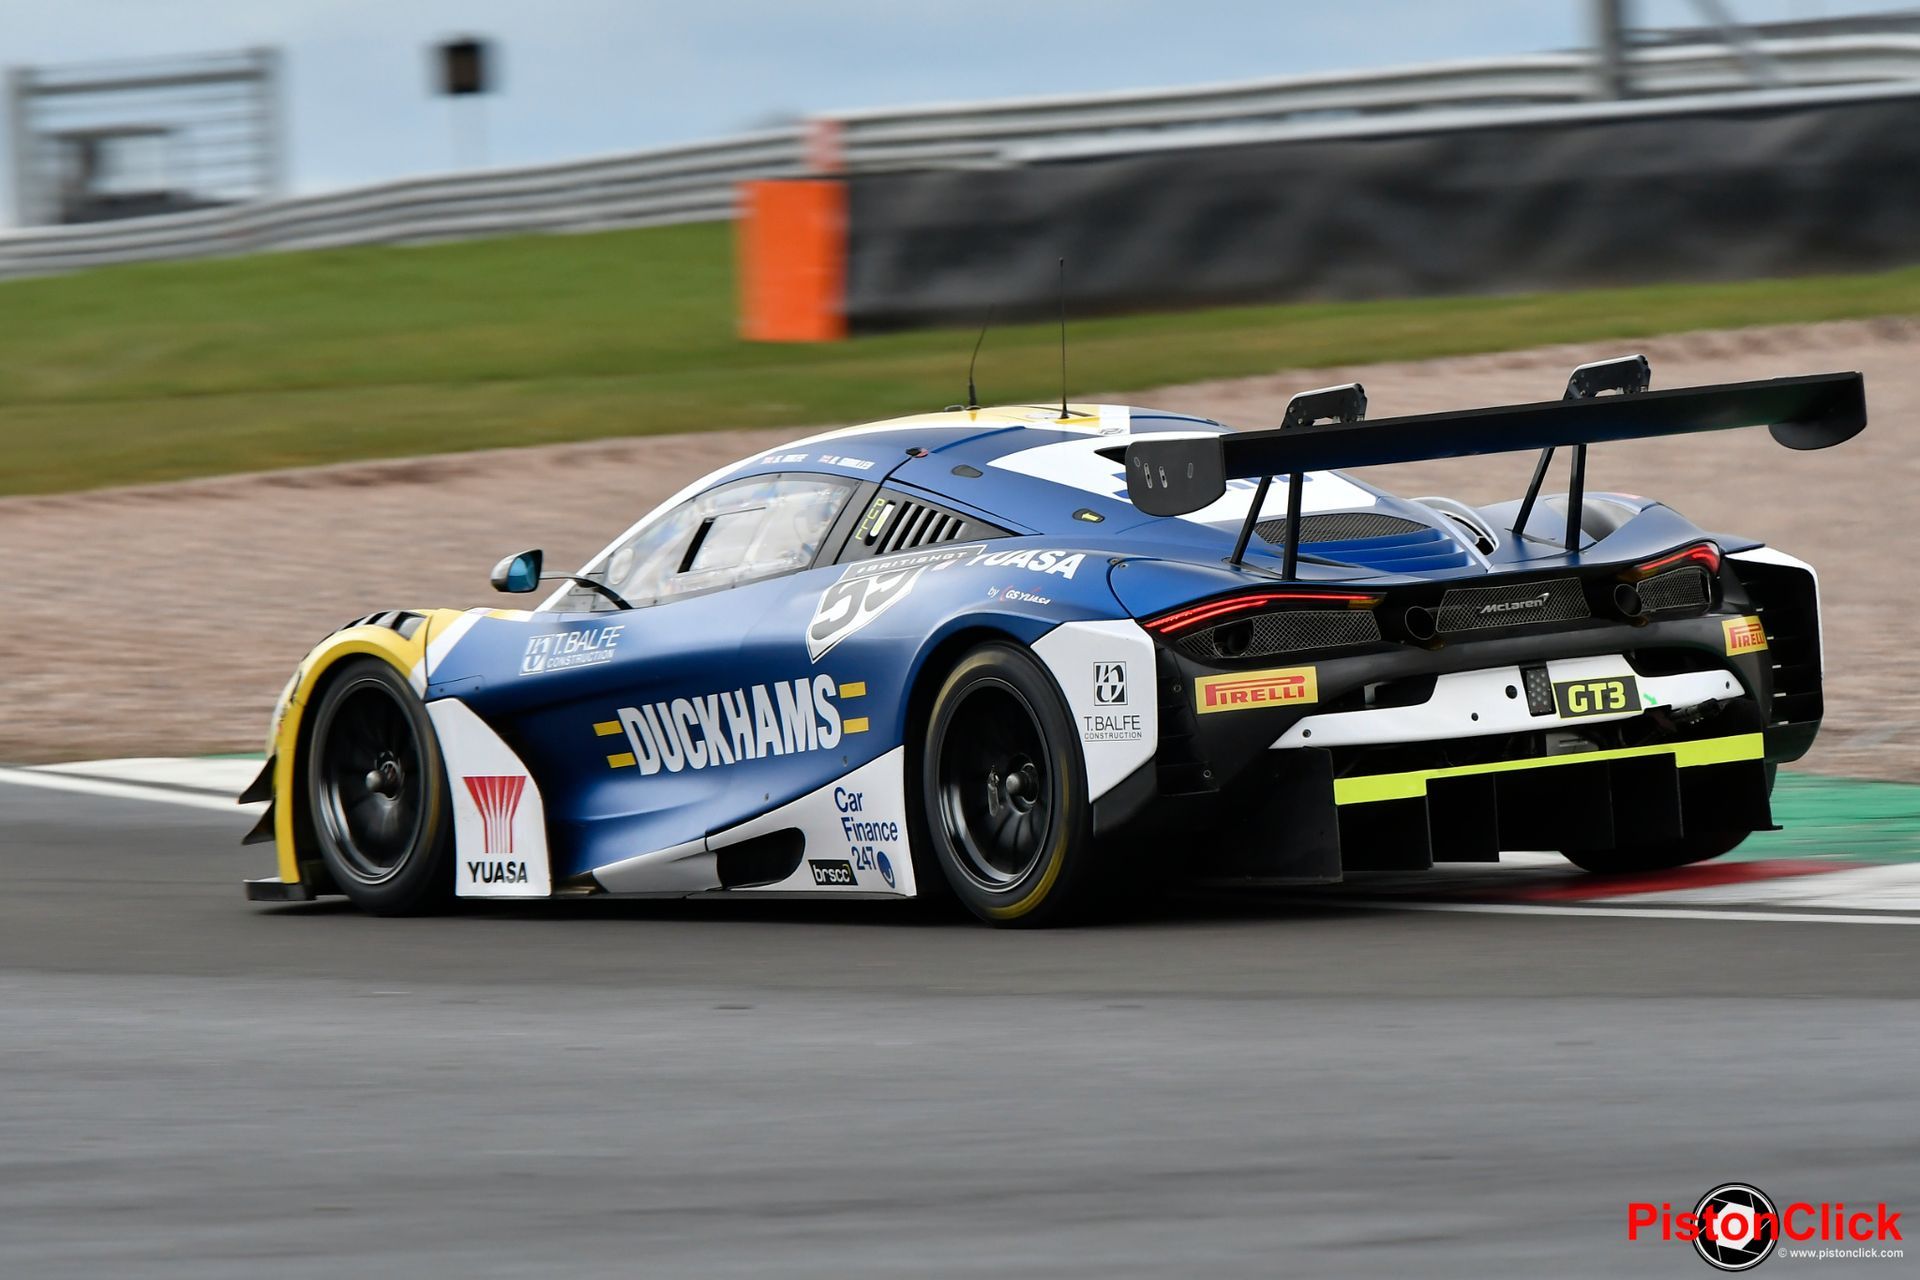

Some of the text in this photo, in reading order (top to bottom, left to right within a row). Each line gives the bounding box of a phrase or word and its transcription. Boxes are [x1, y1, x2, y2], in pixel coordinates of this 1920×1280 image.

[855, 498, 885, 540] PULL
[966, 549, 1087, 580] YUASA
[987, 586, 999, 598] by
[1480, 599, 1543, 614] McLaren
[546, 649, 616, 668] CONSTRUCTION
[1205, 675, 1305, 706] PIRELLI
[1568, 681, 1627, 713] GT3
[617, 674, 842, 776] DUCKHAMS
[1084, 731, 1142, 740] CONSTRUCTION
[834, 787, 863, 812] Car
[841, 817, 898, 842] Finance
[851, 846, 877, 871] 247
[467, 861, 528, 883] YUASA
[812, 864, 851, 883] brscc
